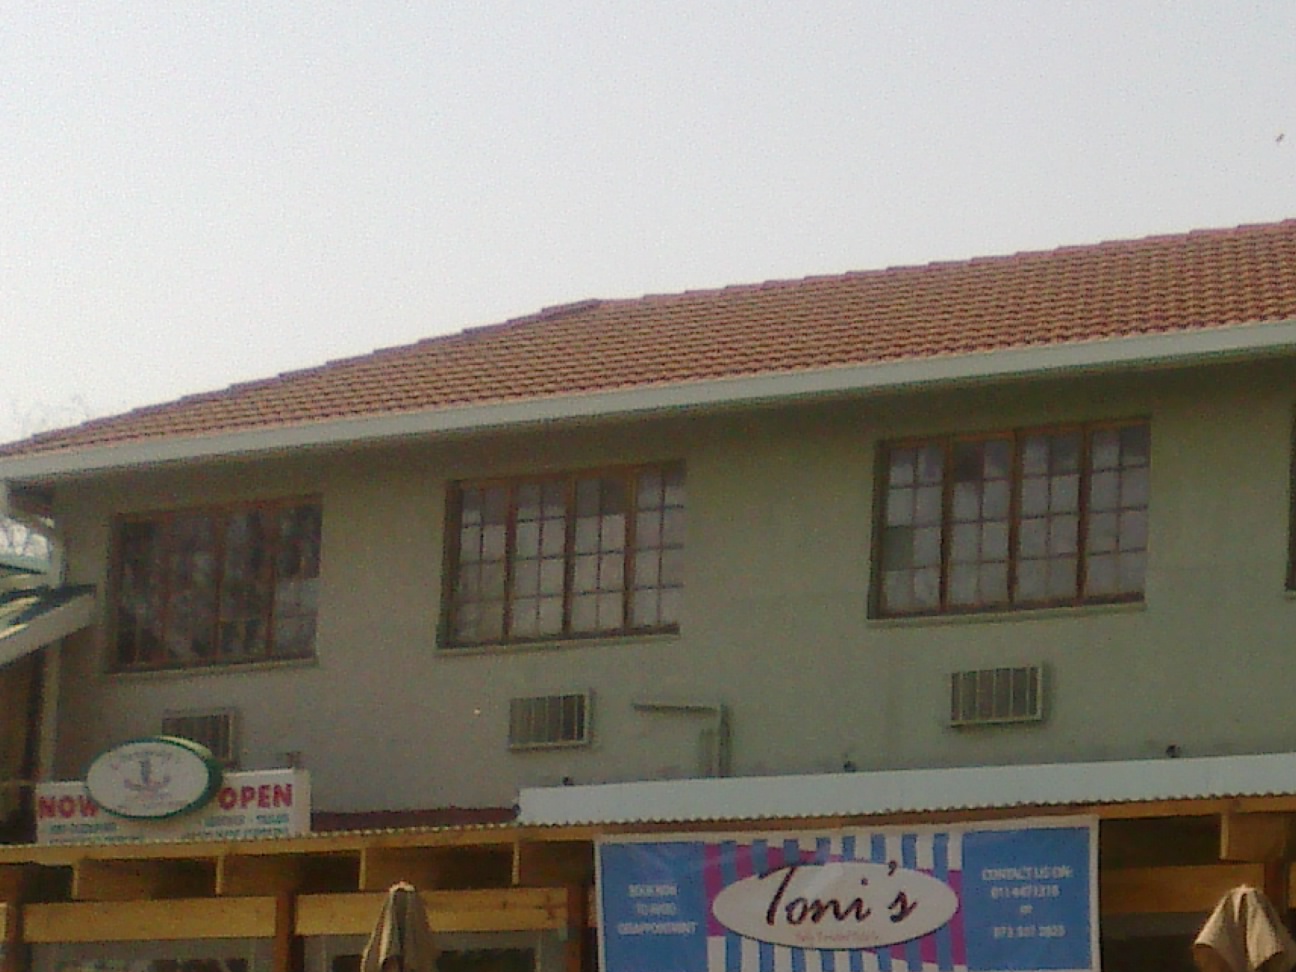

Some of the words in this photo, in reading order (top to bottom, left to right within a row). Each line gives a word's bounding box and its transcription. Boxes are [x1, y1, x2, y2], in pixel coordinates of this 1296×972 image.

[38, 795, 99, 819] NOW
[217, 783, 293, 811] OPEN
[758, 860, 917, 926] Toni's
